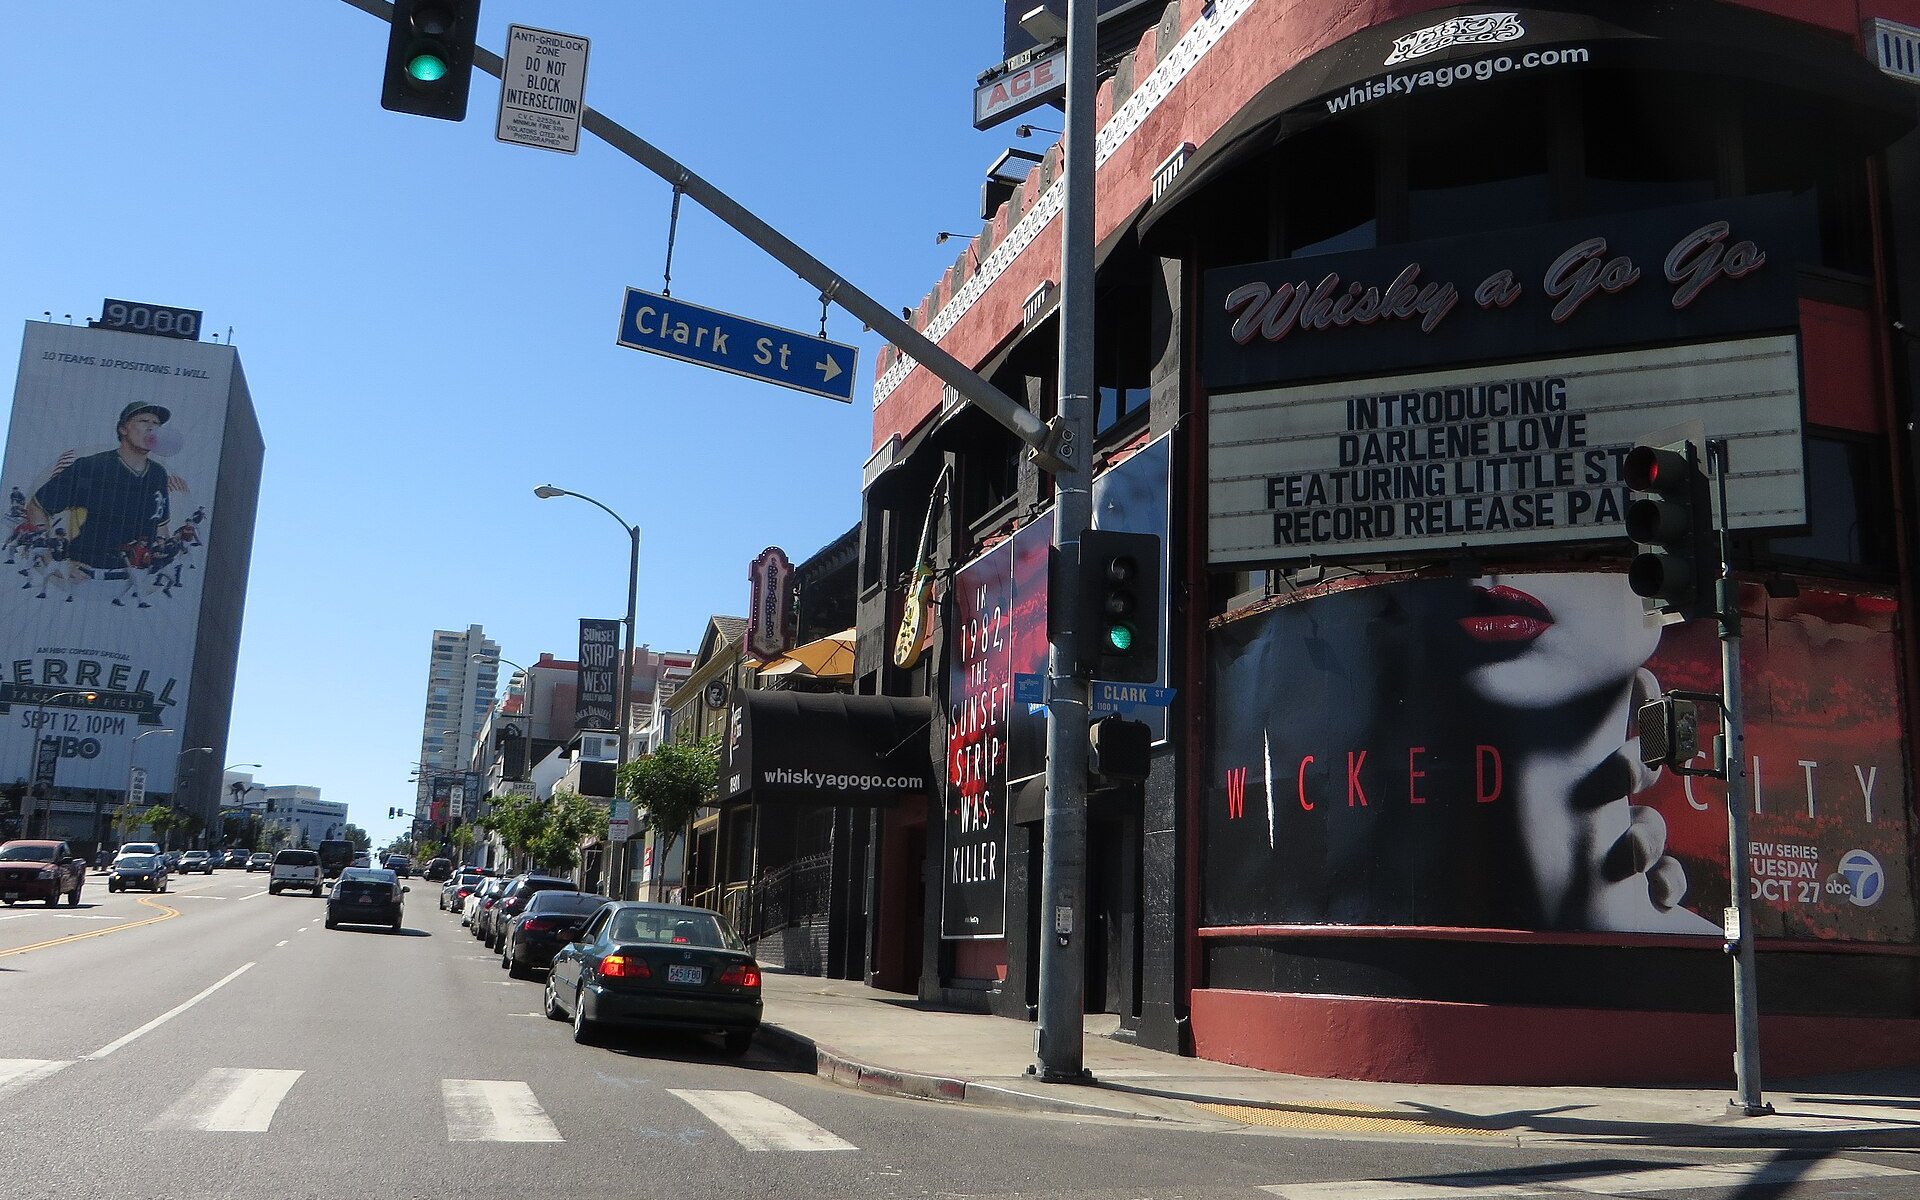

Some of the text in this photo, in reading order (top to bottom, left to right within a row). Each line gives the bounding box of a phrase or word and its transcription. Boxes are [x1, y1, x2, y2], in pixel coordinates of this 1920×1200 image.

[514, 32, 584, 52] ANTI-GRIDLOCK
[536, 46, 560, 57] ZONE
[526, 56, 567, 76] DO NOT
[527, 75, 560, 93] BLOCK
[987, 60, 1054, 110] ACE
[1326, 48, 1589, 114] whiskyagogo.com
[507, 89, 577, 114] INTERSECTION
[506, 125, 537, 136] VIOLATORS
[1225, 220, 1766, 344] Whisky a Go Go
[108, 303, 196, 336] 9000
[635, 306, 791, 371] Clark St
[43, 352, 57, 361] 10
[100, 357, 113, 368] 10
[1346, 378, 1566, 431] INTRODUCING
[1339, 414, 1587, 467] DARLENE LOVE
[1266, 463, 1446, 508] FEATURING
[1455, 452, 1574, 493] LITTLE
[1273, 487, 1631, 544] RECORD RELEASE PA
[583, 628, 617, 642] SUNSET
[961, 606, 1005, 662] 1982,
[100, 650, 131, 661] SPECIAL
[582, 643, 615, 668] STRIP
[0, 659, 178, 706] ERRELL
[583, 671, 613, 693] WEST
[970, 658, 988, 688] THE
[104, 699, 145, 710] FIELD
[1104, 685, 1163, 703] CLARK ST
[21, 710, 60, 730] SEPT
[86, 716, 126, 735] 10PM
[951, 682, 1009, 740] SUNSET
[44, 735, 102, 759] HBO
[955, 738, 999, 787] STRIP
[764, 768, 923, 790] whiskyagogo.com
[1684, 751, 1877, 823] CITY
[961, 791, 990, 834] WAS
[952, 841, 997, 884] KILLER
[1776, 844, 1819, 860] SERIES
[1750, 858, 1818, 879] UESDAY
[1797, 881, 1820, 903] 27
[1825, 880, 1852, 895] abc
